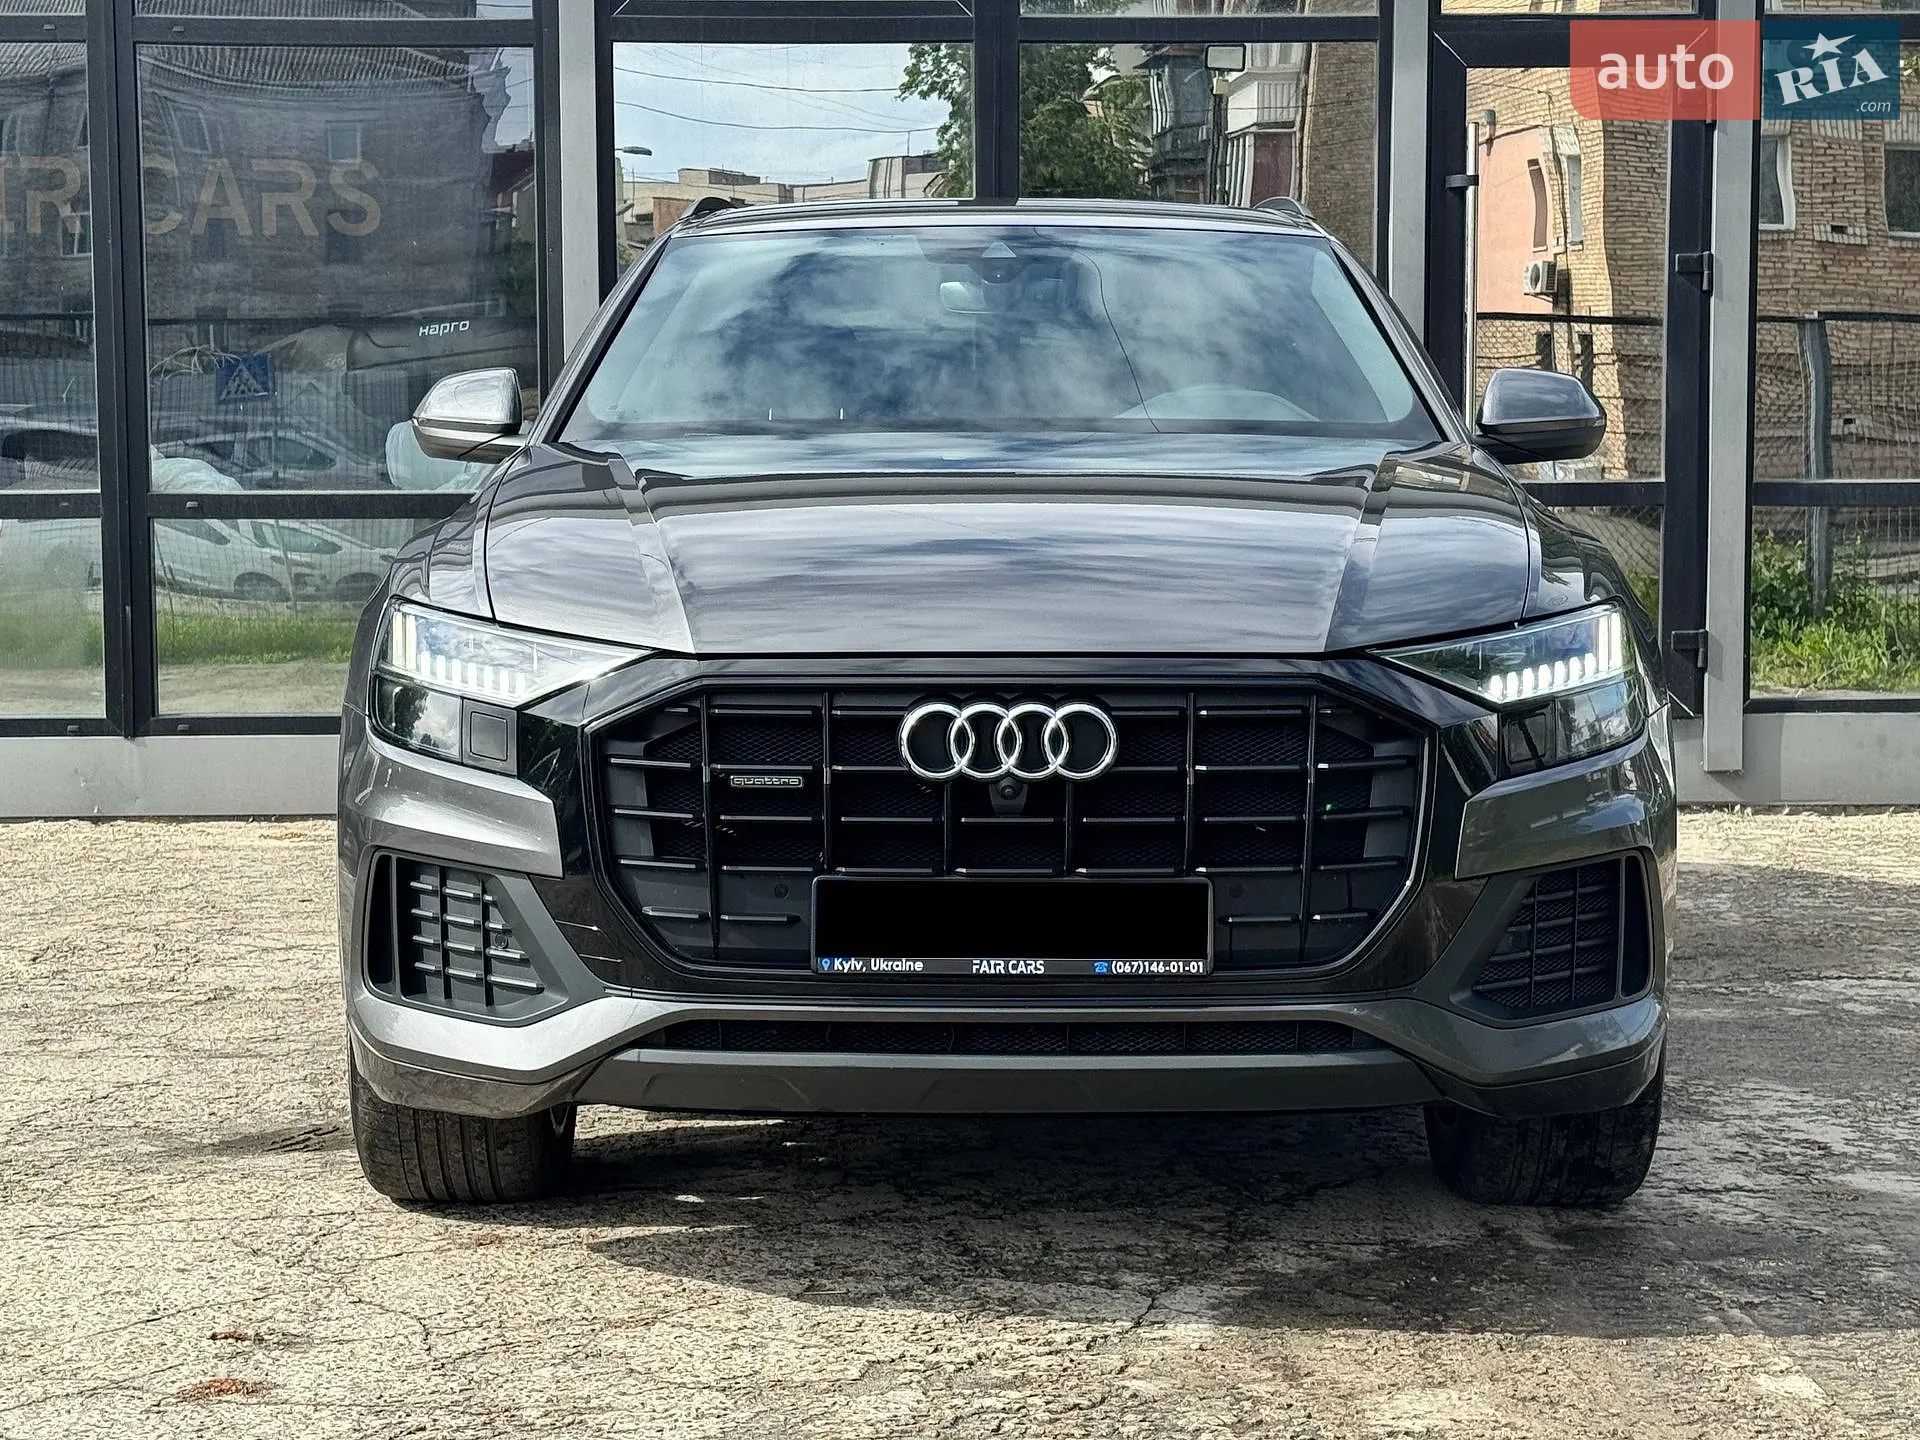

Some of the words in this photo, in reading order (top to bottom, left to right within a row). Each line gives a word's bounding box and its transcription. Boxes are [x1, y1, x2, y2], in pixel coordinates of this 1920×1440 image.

[143, 153, 382, 237] CARS
[732, 776, 800, 787] quattro
[833, 958, 867, 973] Kyiv,
[870, 958, 924, 972] Ukraine
[972, 960, 1005, 974] FAIR
[1008, 960, 1045, 975] CARS
[1111, 961, 1204, 975] (067)146-01-01
